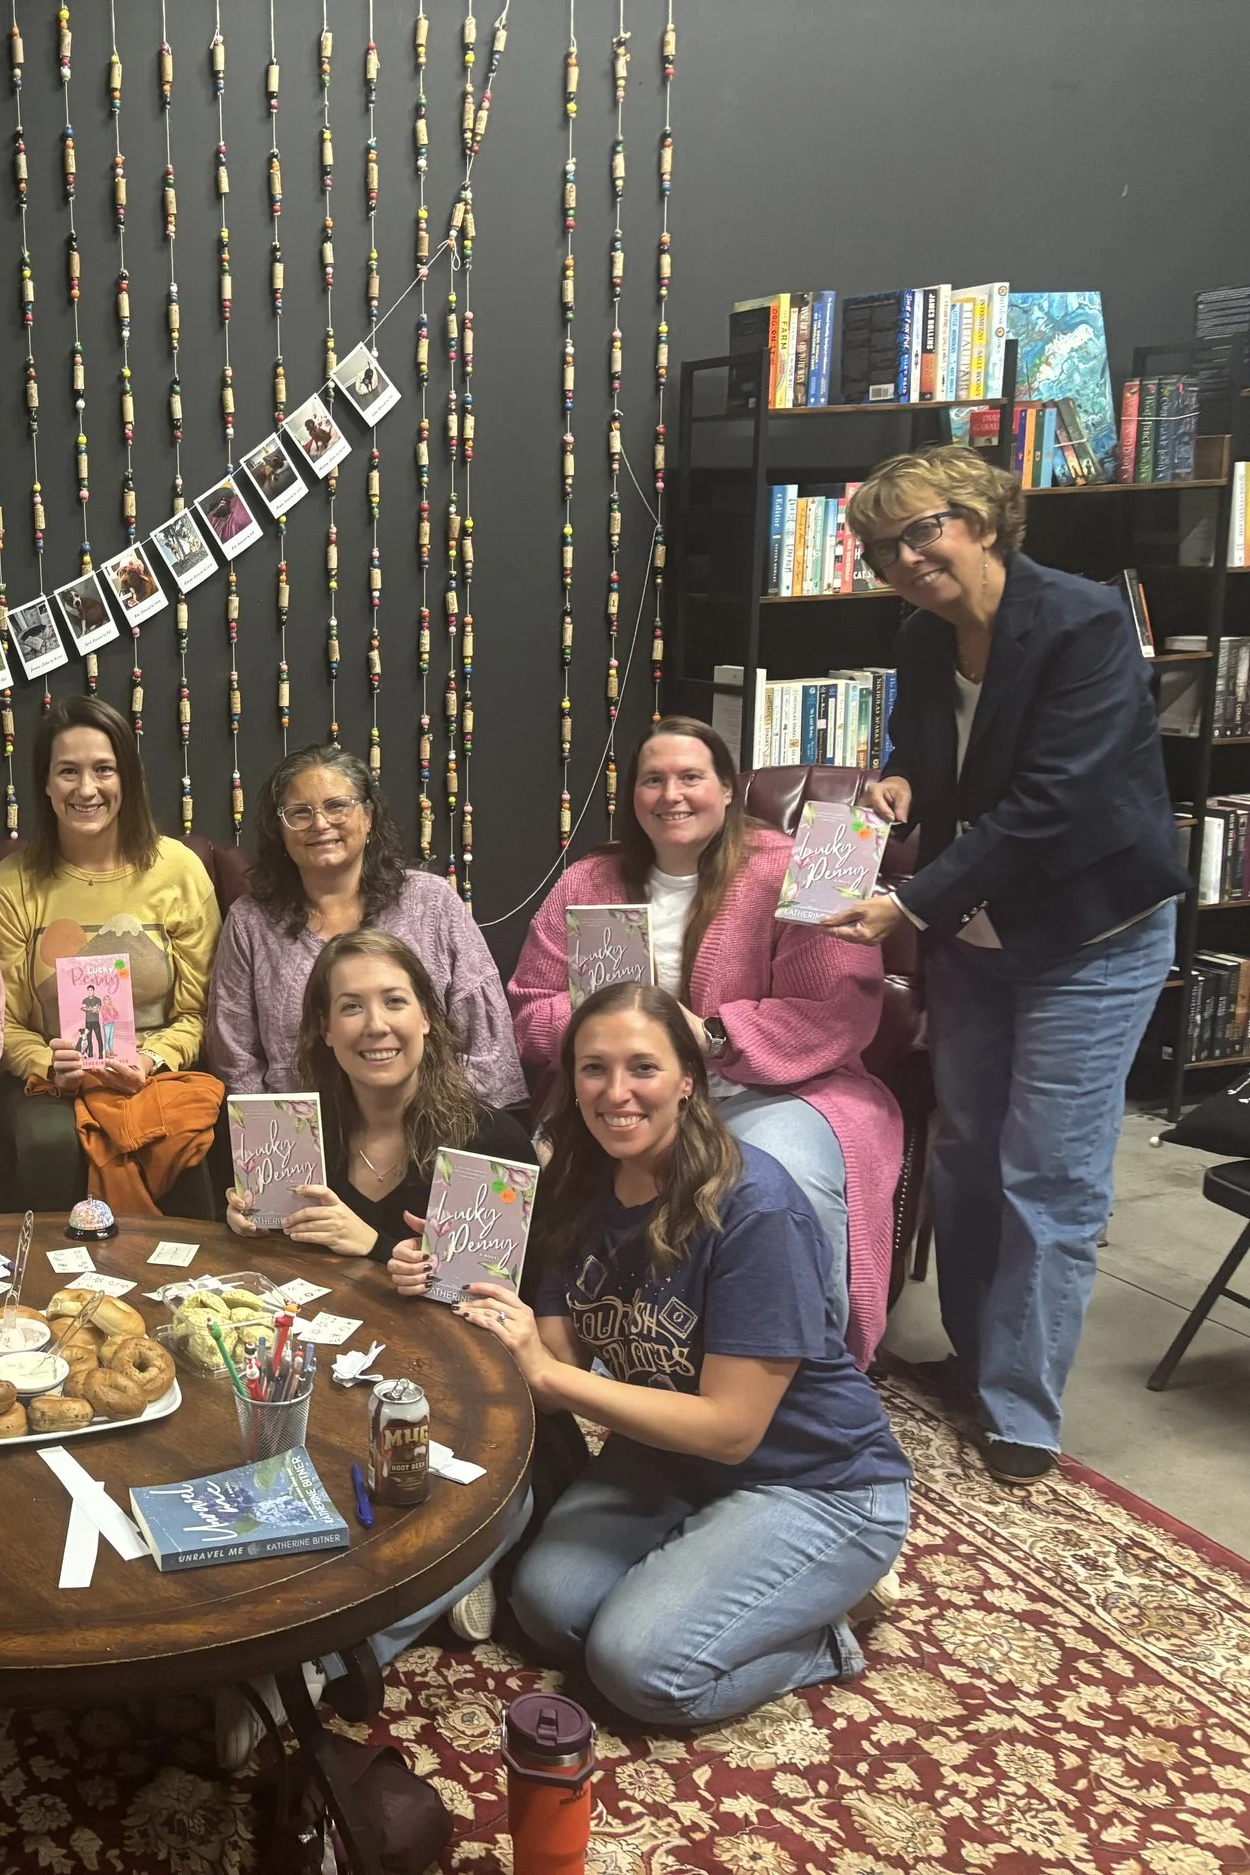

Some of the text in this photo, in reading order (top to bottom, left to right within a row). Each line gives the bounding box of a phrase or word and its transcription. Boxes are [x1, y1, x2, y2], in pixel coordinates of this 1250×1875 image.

[928, 294, 936, 318] JAMES
[780, 321, 788, 350] FARM
[926, 320, 935, 350] ROLLINS
[976, 350, 984, 370] SALLY
[774, 498, 782, 528] Editor
[800, 824, 858, 868] Lucky
[806, 856, 869, 892] Penny
[576, 927, 628, 970] Lucky
[71, 967, 120, 994] Penny
[88, 966, 115, 974] Lucky
[588, 962, 646, 993] Penny
[241, 1120, 296, 1168] Lucky
[256, 1158, 317, 1194] Penny
[436, 1183, 502, 1238] Lucky
[446, 1224, 518, 1270] Penny
[430, 1287, 470, 1302] ATHERIN
[384, 1424, 428, 1450] MUG
[292, 1456, 312, 1487] BITNER
[411, 1462, 426, 1470] BEER
[150, 1484, 238, 1542] Unravel
[206, 1481, 238, 1512] me
[308, 1488, 334, 1523] KATHERINE
[178, 1534, 340, 1563] UNRAVEL ME KATHERINE BITNER
